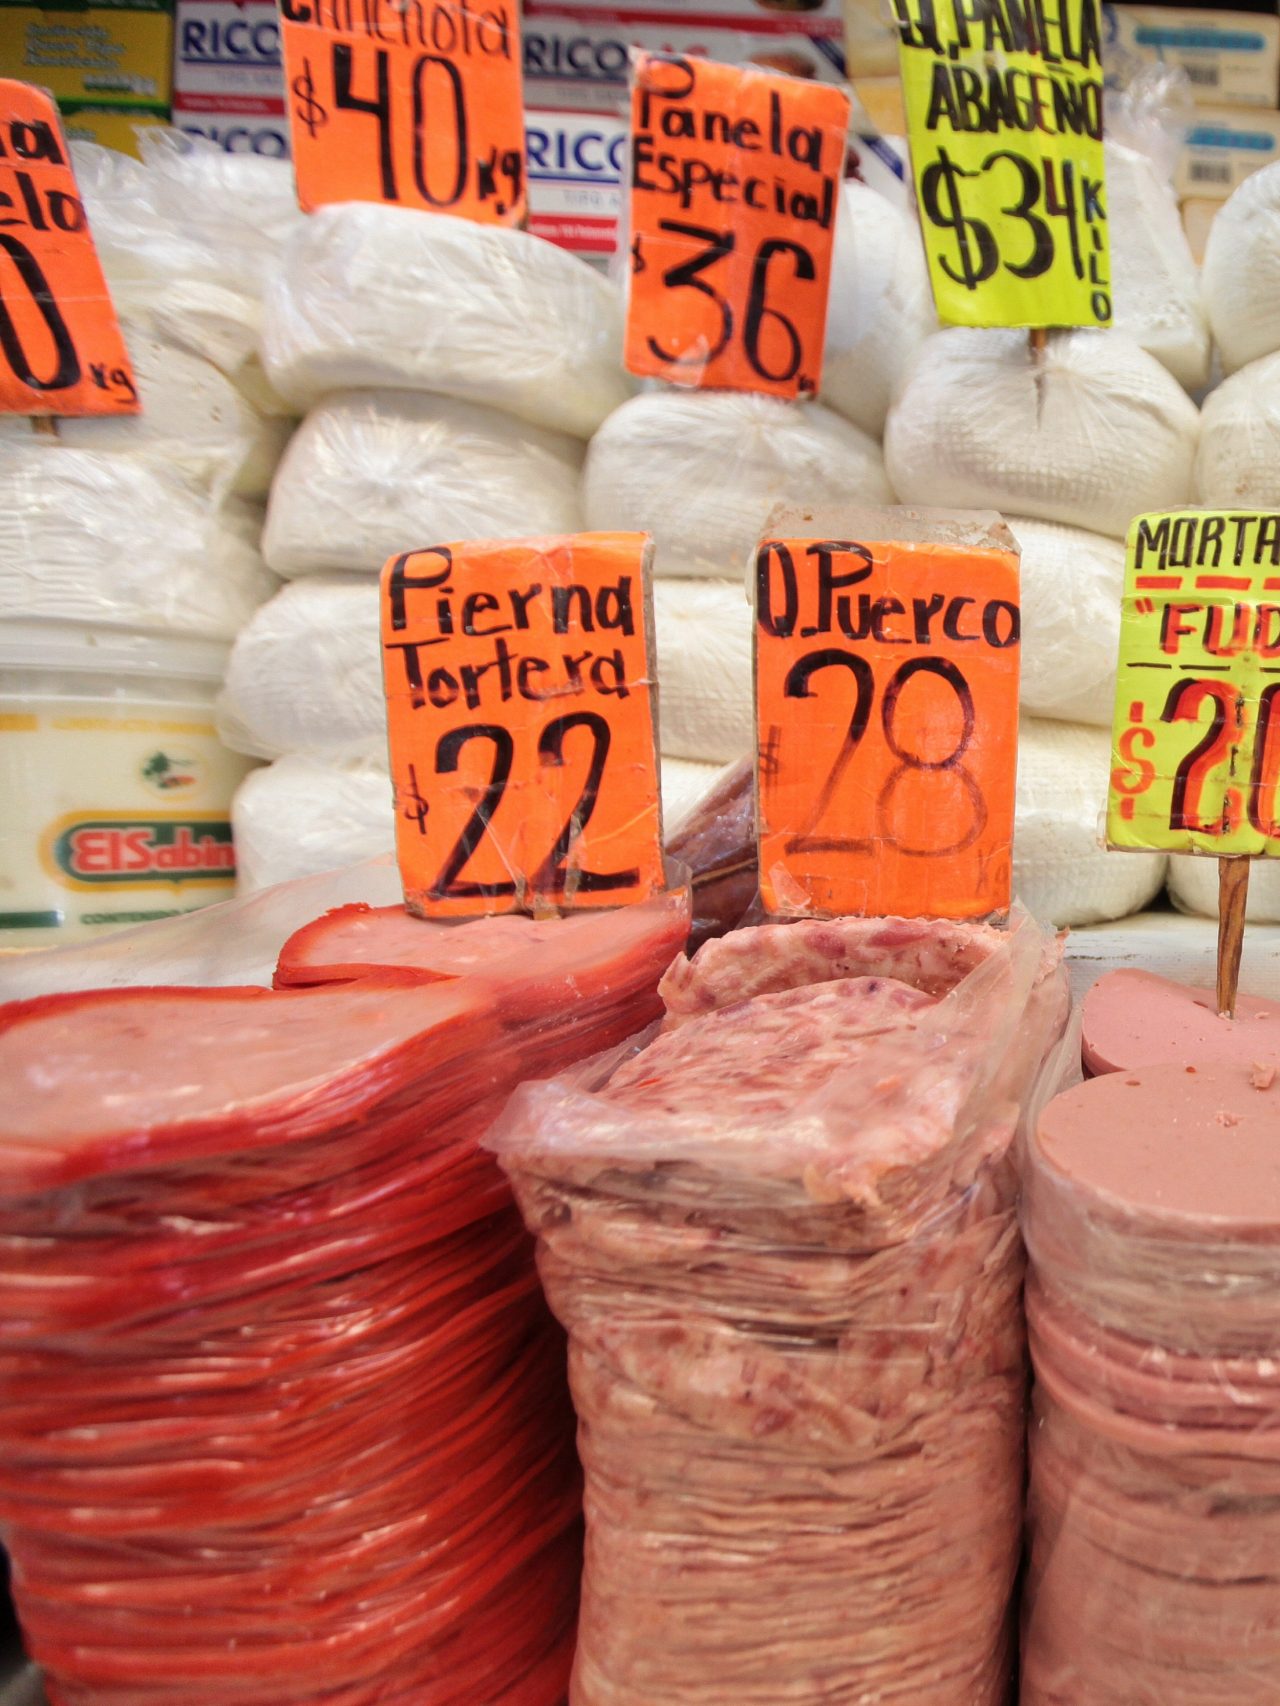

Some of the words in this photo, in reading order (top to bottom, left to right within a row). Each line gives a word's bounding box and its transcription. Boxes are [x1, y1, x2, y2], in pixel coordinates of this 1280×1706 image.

[183, 19, 280, 55] RICO
[524, 33, 628, 72] RICO
[636, 54, 823, 171] Panela
[921, 146, 1085, 290] $34
[1081, 176, 1112, 322] KILO
[387, 546, 636, 638] Pierna
[385, 636, 632, 710] Tortera
